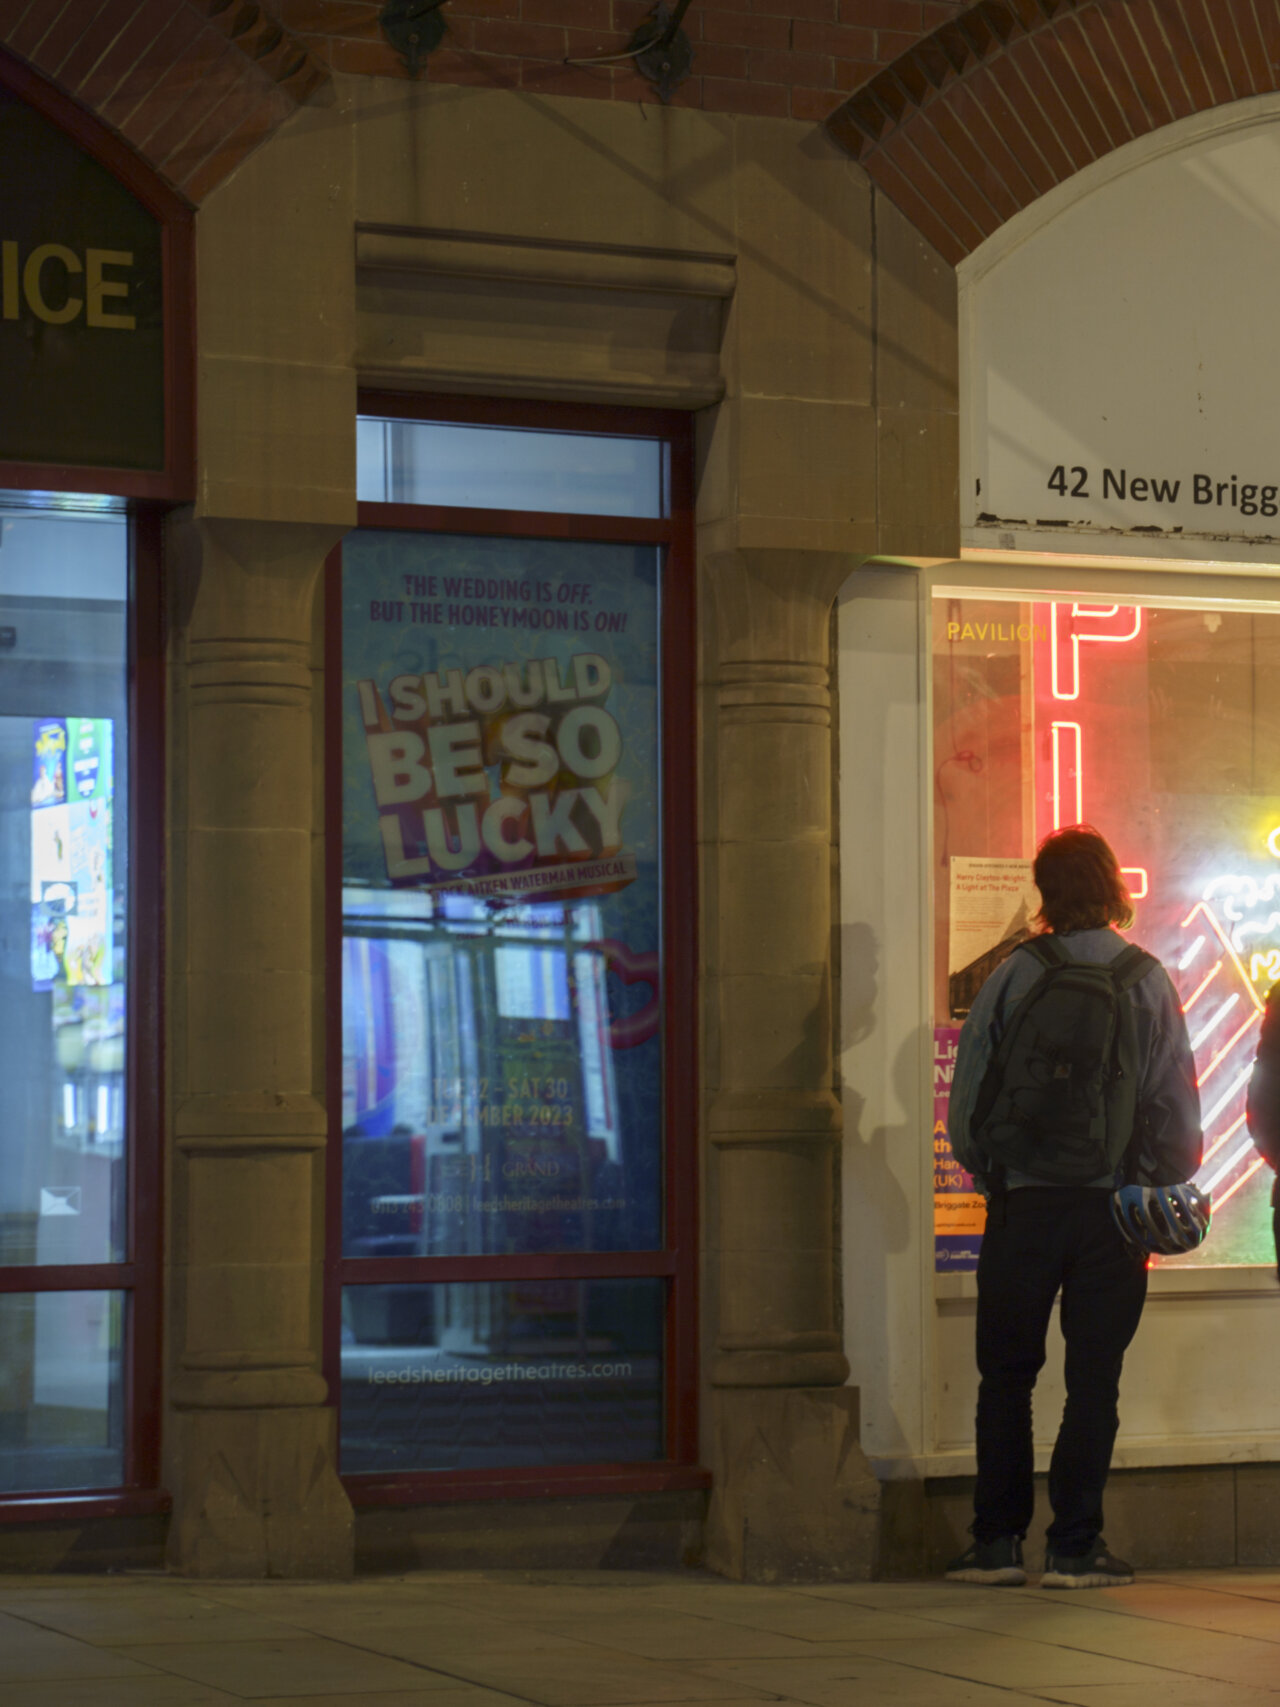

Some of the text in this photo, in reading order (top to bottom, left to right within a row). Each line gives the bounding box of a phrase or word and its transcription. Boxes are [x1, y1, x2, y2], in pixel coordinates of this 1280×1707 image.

[1047, 465, 1089, 498] 42
[1103, 468, 1180, 503] New
[404, 575, 593, 604] THE WEDDING IS OFF.
[370, 600, 628, 633] BUT THE HONEYMOON IS ON!
[947, 622, 1047, 642] PAVILION
[357, 680, 379, 727] I
[389, 653, 612, 721] SHOULD
[366, 705, 623, 806] BE SO
[379, 777, 632, 879] LUCKY
[468, 879, 507, 897] AITKEN
[511, 870, 576, 891] WATERMAN
[577, 861, 627, 880] MUSICAL
[432, 1078, 466, 1100] TUE
[508, 1078, 540, 1099] SAT
[546, 1077, 568, 1099] 30
[532, 1104, 574, 1126] 2023
[502, 1159, 560, 1177] GRAND
[934, 1174, 963, 1188] (UK)
[368, 1362, 632, 1385] leedsheritagetheatres.com
